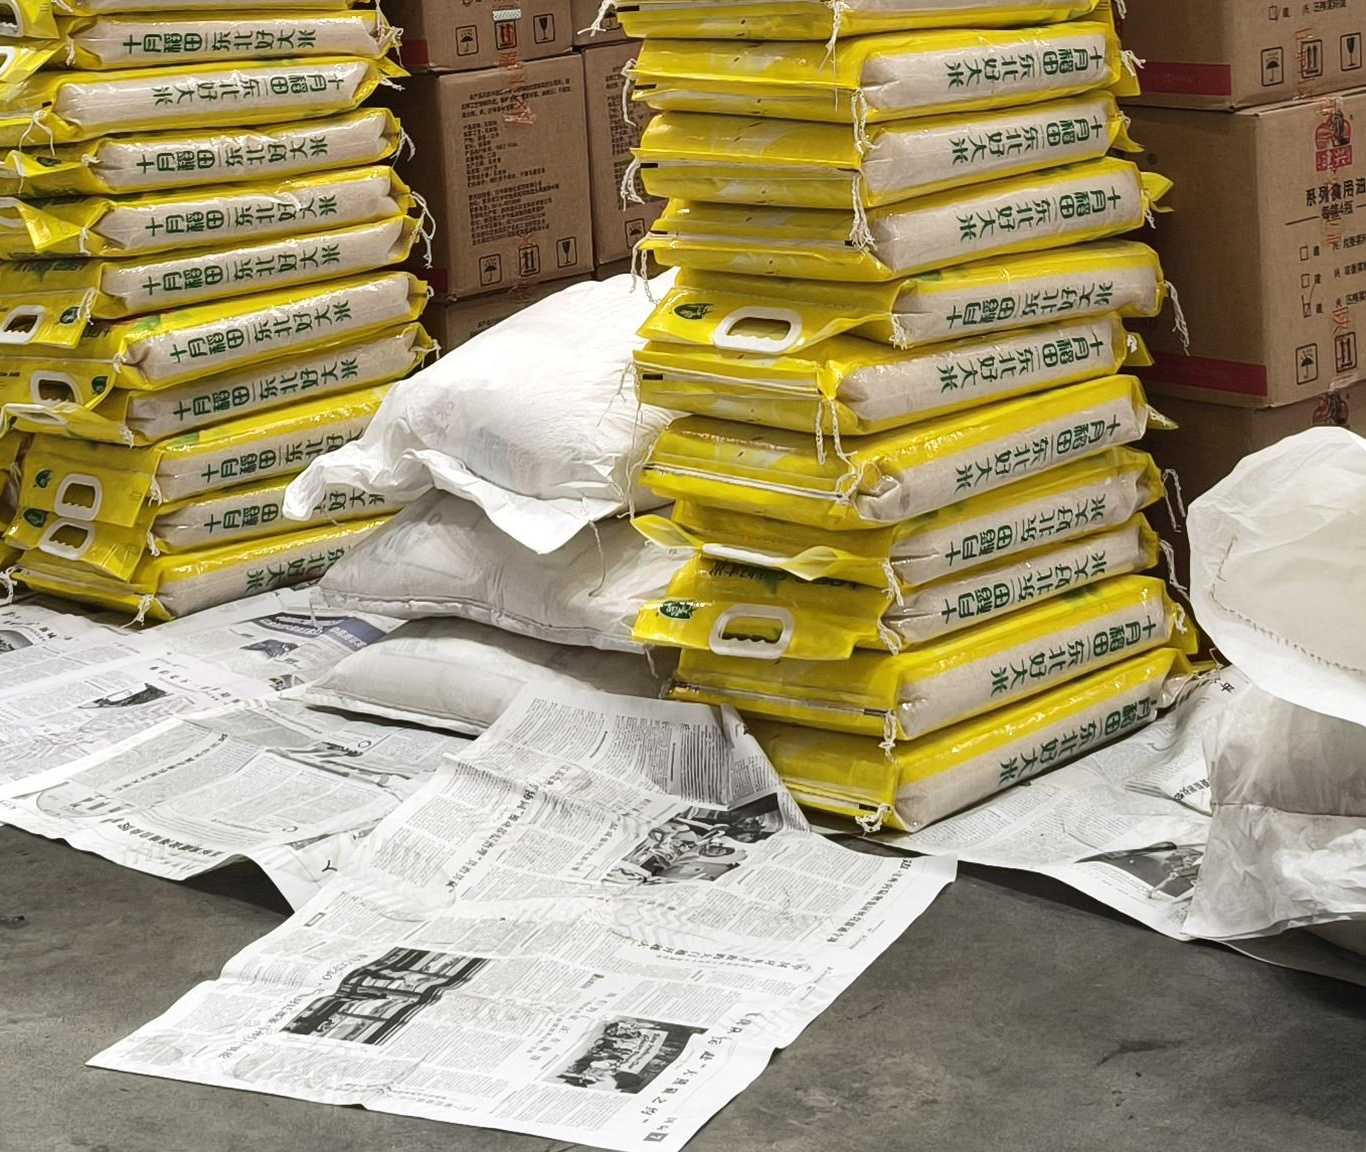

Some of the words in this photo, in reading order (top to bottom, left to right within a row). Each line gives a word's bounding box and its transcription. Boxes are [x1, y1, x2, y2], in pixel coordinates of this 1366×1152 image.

[122, 32, 208, 54] 十月稻田
[211, 30, 316, 51] 东北好大米
[1042, 48, 1102, 76] 十月稻田
[266, 74, 343, 95] 十月稻田
[947, 55, 1035, 87] 东北好大米
[153, 79, 260, 105] 东北好大米
[951, 127, 1039, 164] 东北好大米
[1042, 118, 1102, 147] 十月稻田
[136, 149, 216, 173] 十月稻田
[224, 137, 328, 167] 东北好大米
[1059, 189, 1121, 219] 十月稻田
[1306, 177, 1366, 206] 系列食用油
[145, 209, 225, 236] 十月稻田
[234, 196, 337, 227] 东北好大米
[959, 200, 1051, 240] 东北好大米
[143, 265, 229, 295] 十月稻田
[234, 245, 340, 281] 东北好大米
[946, 297, 1016, 326] 十月稻田
[1021, 284, 1113, 316] 东北好大米
[170, 328, 245, 362] 十月稻田
[253, 302, 351, 342] 东北好大米
[1038, 336, 1103, 368] 十月稻田
[173, 385, 250, 419] 十月稻田
[259, 359, 358, 399] 东北好大米
[939, 349, 1034, 391] 东北好大米
[201, 449, 277, 481] 十月稻田
[285, 427, 364, 463] 东北好
[1050, 418, 1120, 455] 十月稻田
[956, 438, 1049, 489] 东北好大米
[204, 503, 279, 532] 十月稻田
[313, 488, 385, 513] 好大米
[945, 524, 1018, 564] 十月稻田
[1020, 497, 1106, 542] 东北好大米
[941, 583, 1015, 622] 十月稻田
[1018, 554, 1109, 601] 东北好大米
[1087, 619, 1157, 658] 十月稻田
[990, 640, 1084, 694] 东北好大米
[999, 720, 1096, 785] 东北好大米
